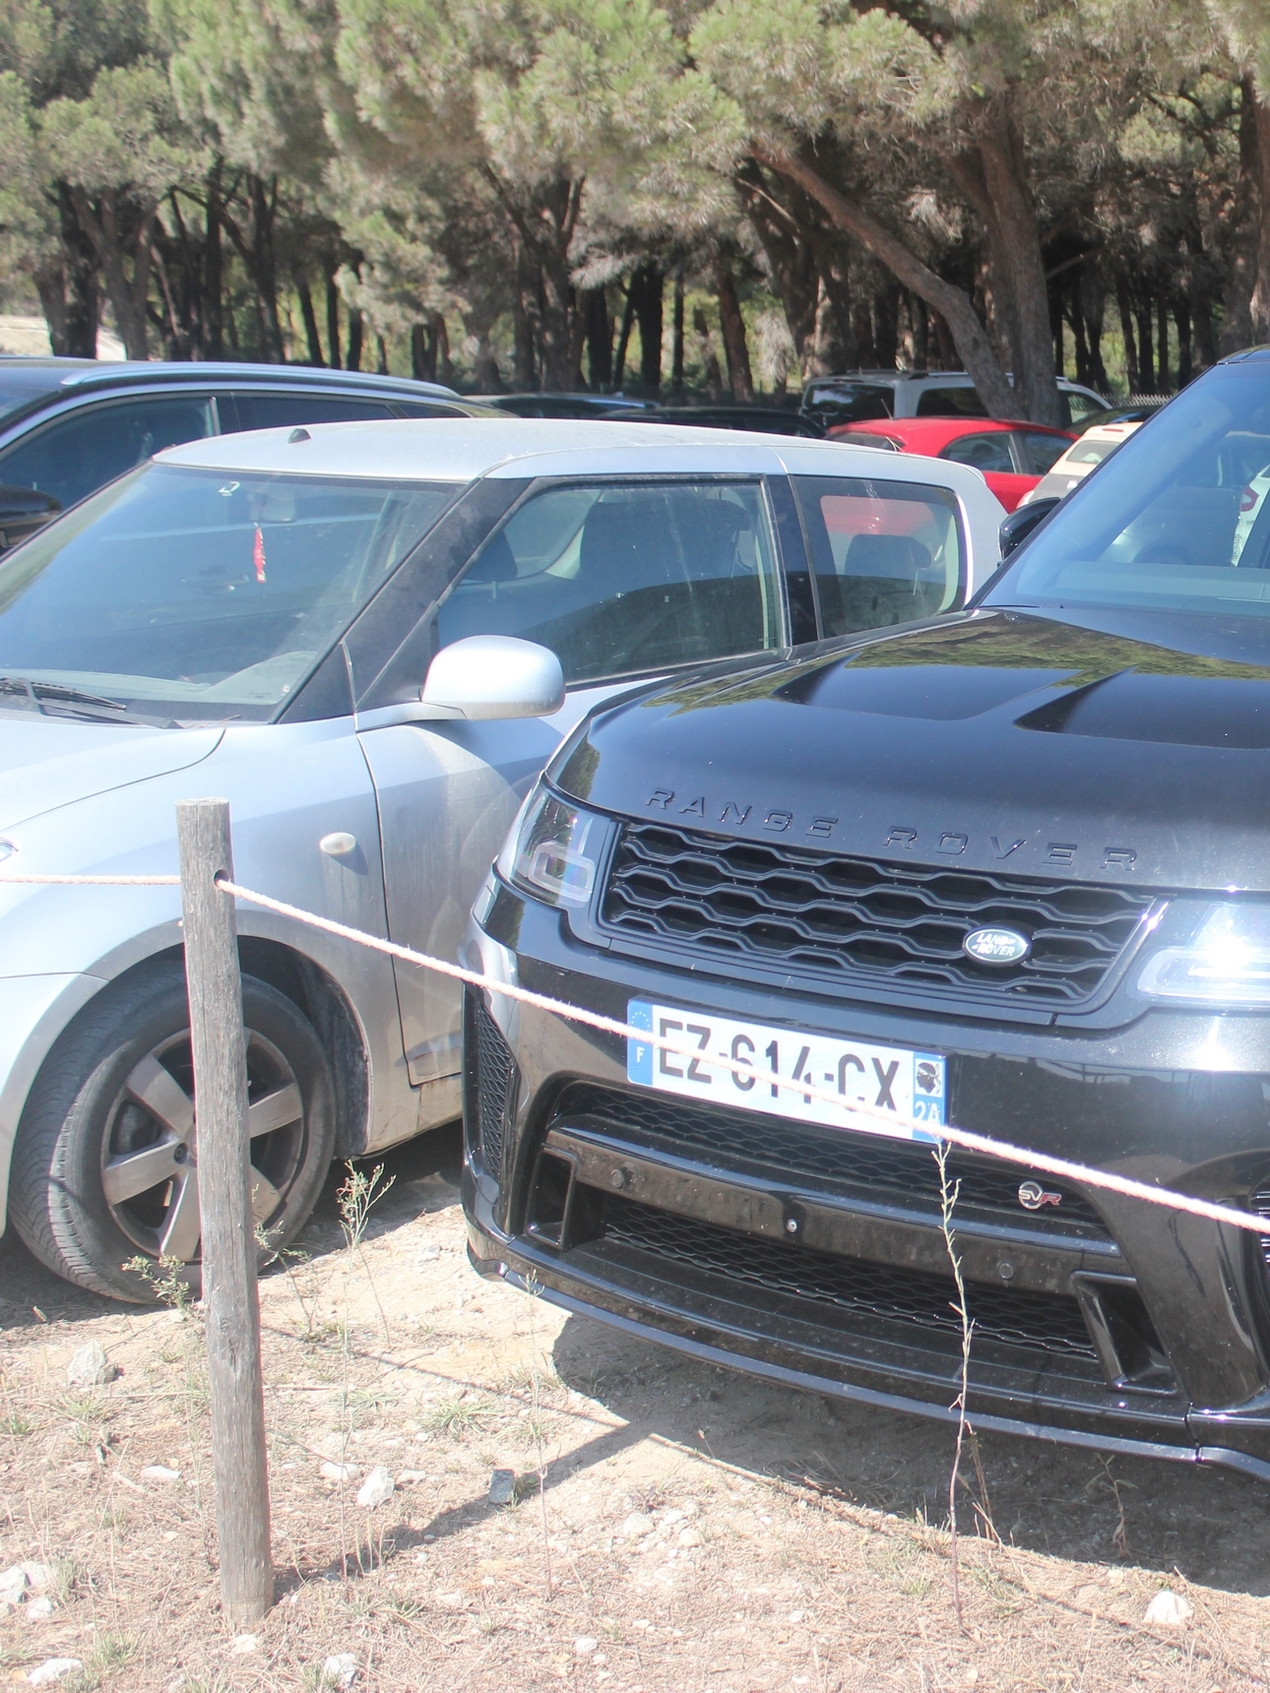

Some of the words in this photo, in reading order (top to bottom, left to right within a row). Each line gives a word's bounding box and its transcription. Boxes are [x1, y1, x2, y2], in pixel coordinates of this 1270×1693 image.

[645, 787, 839, 838] RANGE
[881, 825, 1139, 872] ROVER
[976, 933, 1010, 945] LAND
[976, 943, 1016, 957] ROVER
[636, 1046, 645, 1063] F
